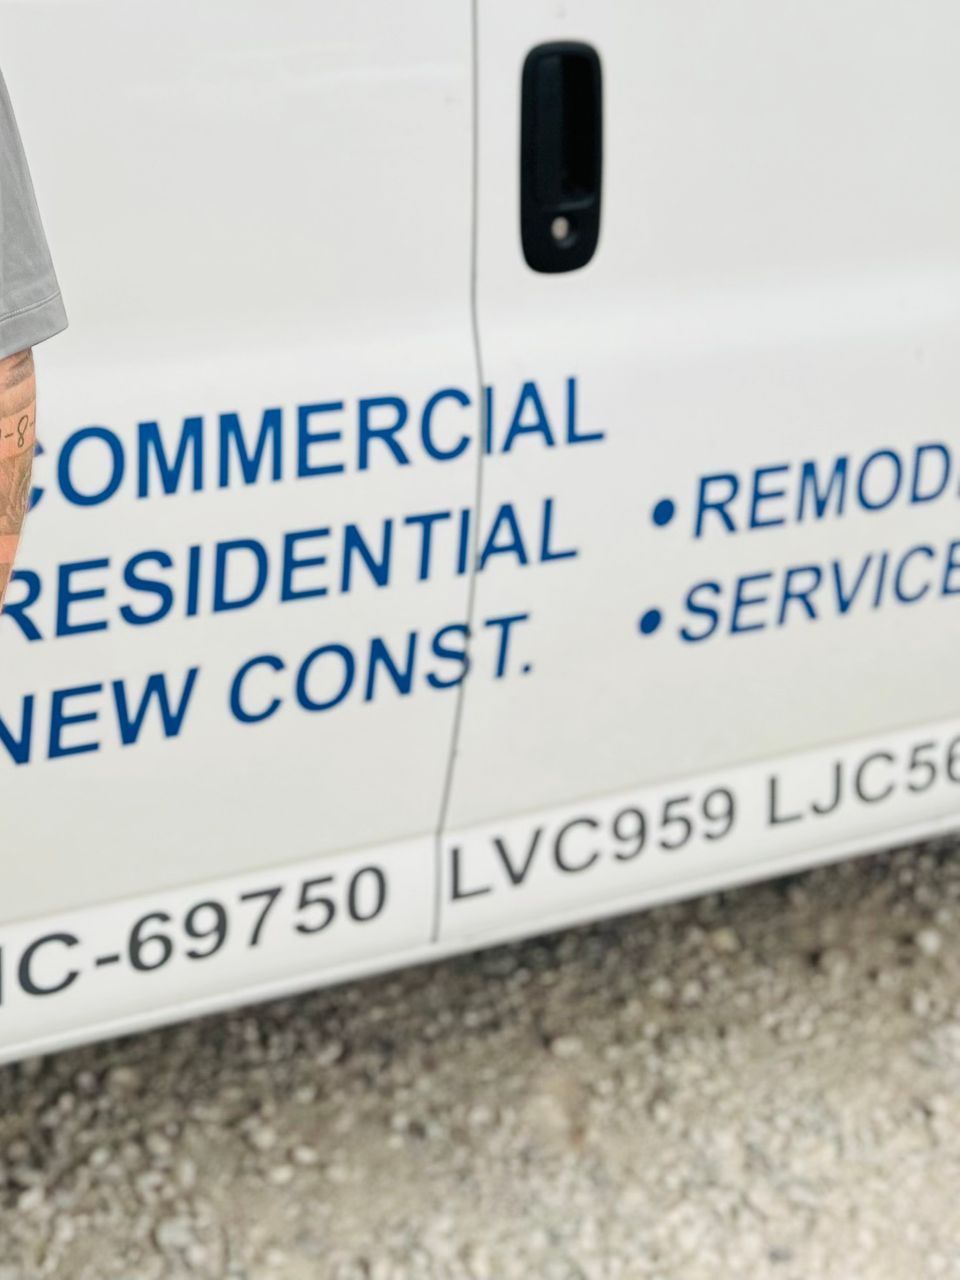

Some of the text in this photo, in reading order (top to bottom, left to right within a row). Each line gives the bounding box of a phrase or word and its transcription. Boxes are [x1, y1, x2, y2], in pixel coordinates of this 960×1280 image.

[26, 376, 605, 514] OMMERCIAL
[693, 443, 960, 540] REMOD
[229, 612, 532, 724] CONST.
[451, 788, 736, 901] LVC959
